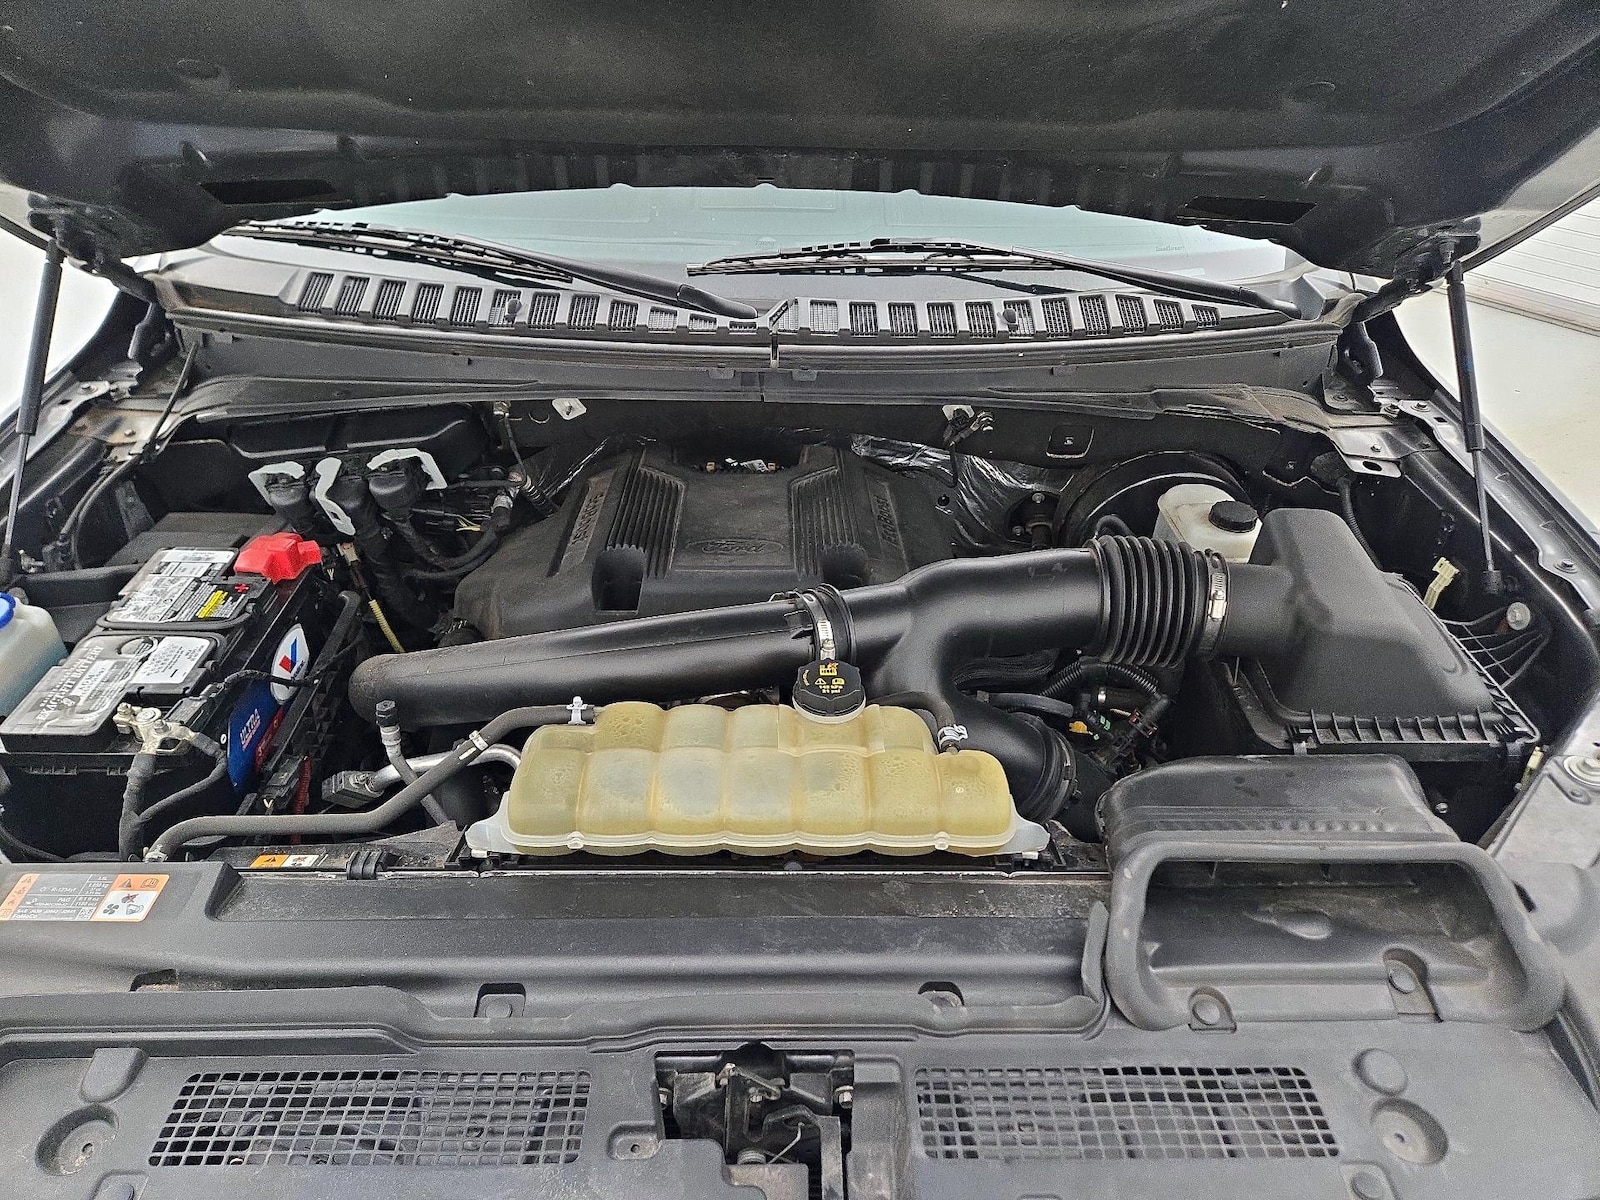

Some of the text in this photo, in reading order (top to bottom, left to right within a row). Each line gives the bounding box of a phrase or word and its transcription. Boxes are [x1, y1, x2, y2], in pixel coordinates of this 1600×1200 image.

[701, 540, 766, 554] Ford
[69, 645, 105, 678] BATTERY
[240, 708, 261, 746] ULTRA
